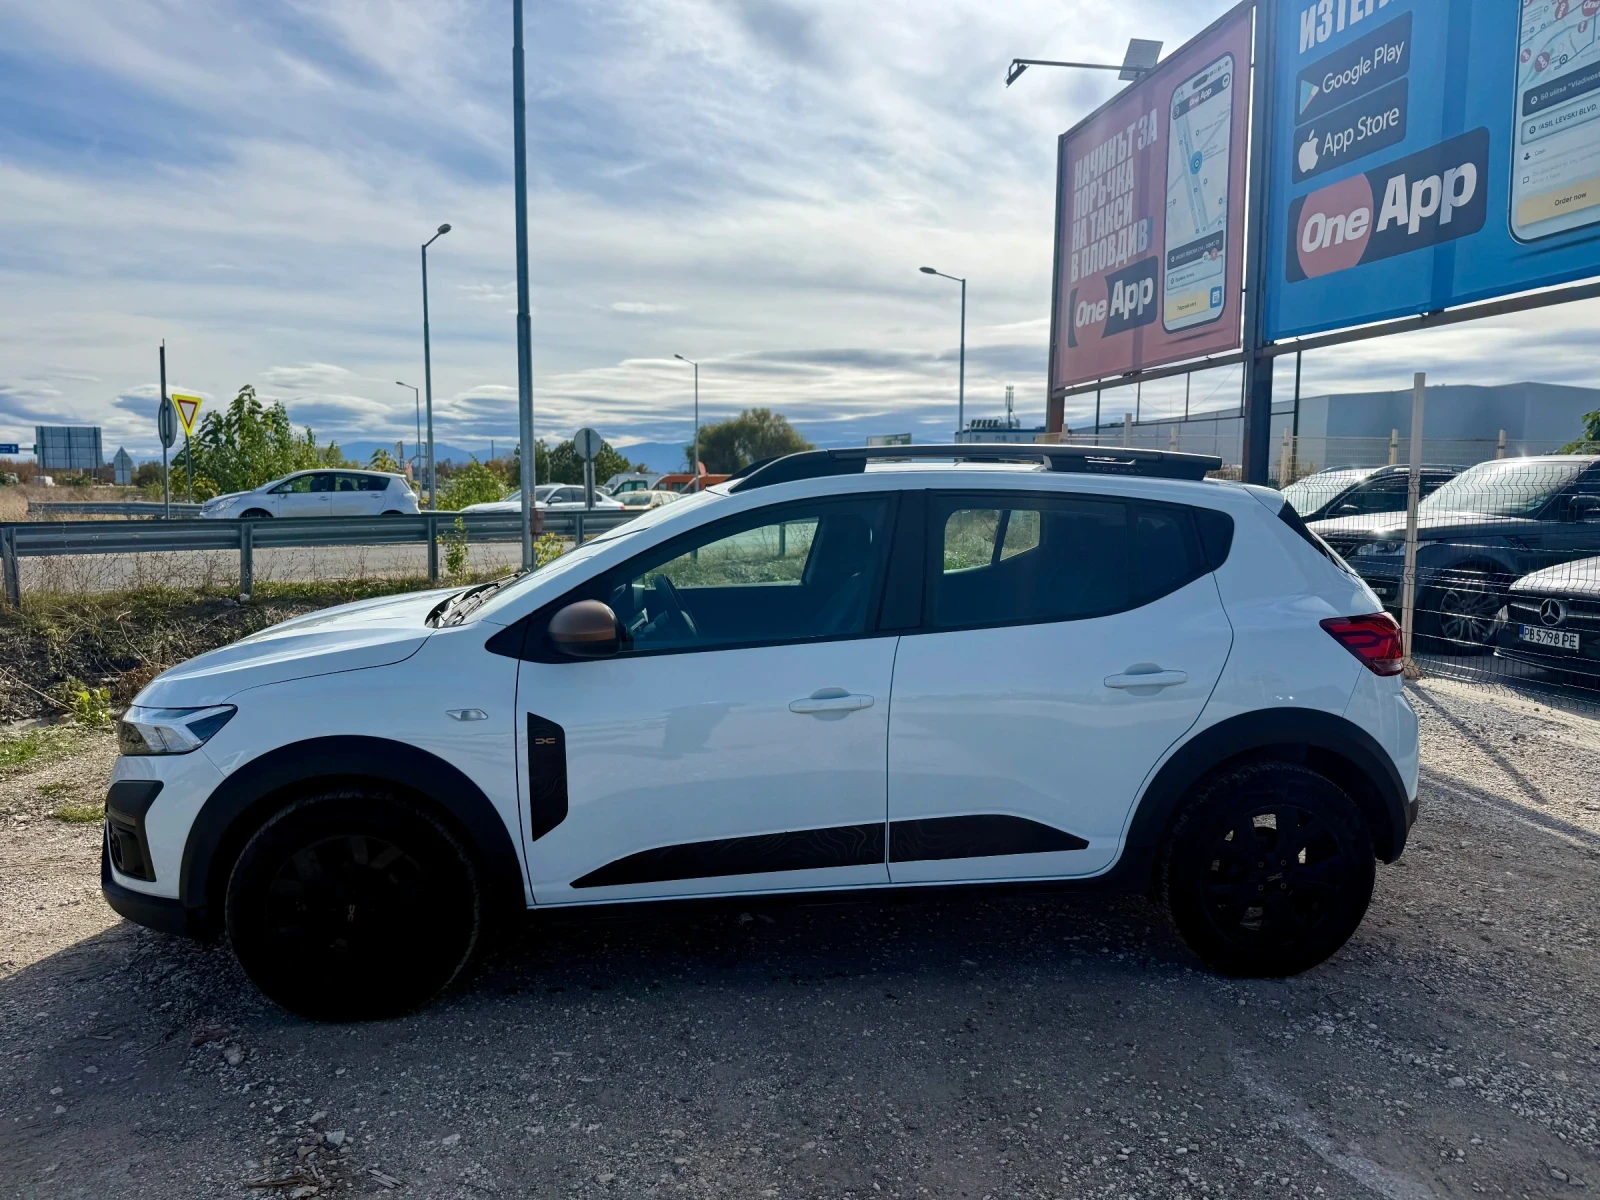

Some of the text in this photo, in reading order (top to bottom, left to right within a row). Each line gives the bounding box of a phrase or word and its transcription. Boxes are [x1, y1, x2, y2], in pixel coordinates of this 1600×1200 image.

[1322, 41, 1405, 94] Google Play
[1549, 86, 1567, 97] ulitsa
[1322, 107, 1400, 157] App Store
[1555, 111, 1578, 125] LEVSKI
[1579, 103, 1598, 116] BLVD.
[1074, 122, 1136, 191] НАЧИНЪТ
[1137, 108, 1158, 151] ЗА
[1073, 157, 1134, 222] ПОРЪЧКА
[1301, 162, 1477, 253] One App
[1554, 191, 1587, 206] Order now
[1072, 190, 1134, 252] НА ТАКСИ
[1070, 253, 1079, 283] В
[1075, 277, 1154, 328] One App
[1536, 630, 1560, 645] 5798
[1562, 634, 1577, 648] PE
